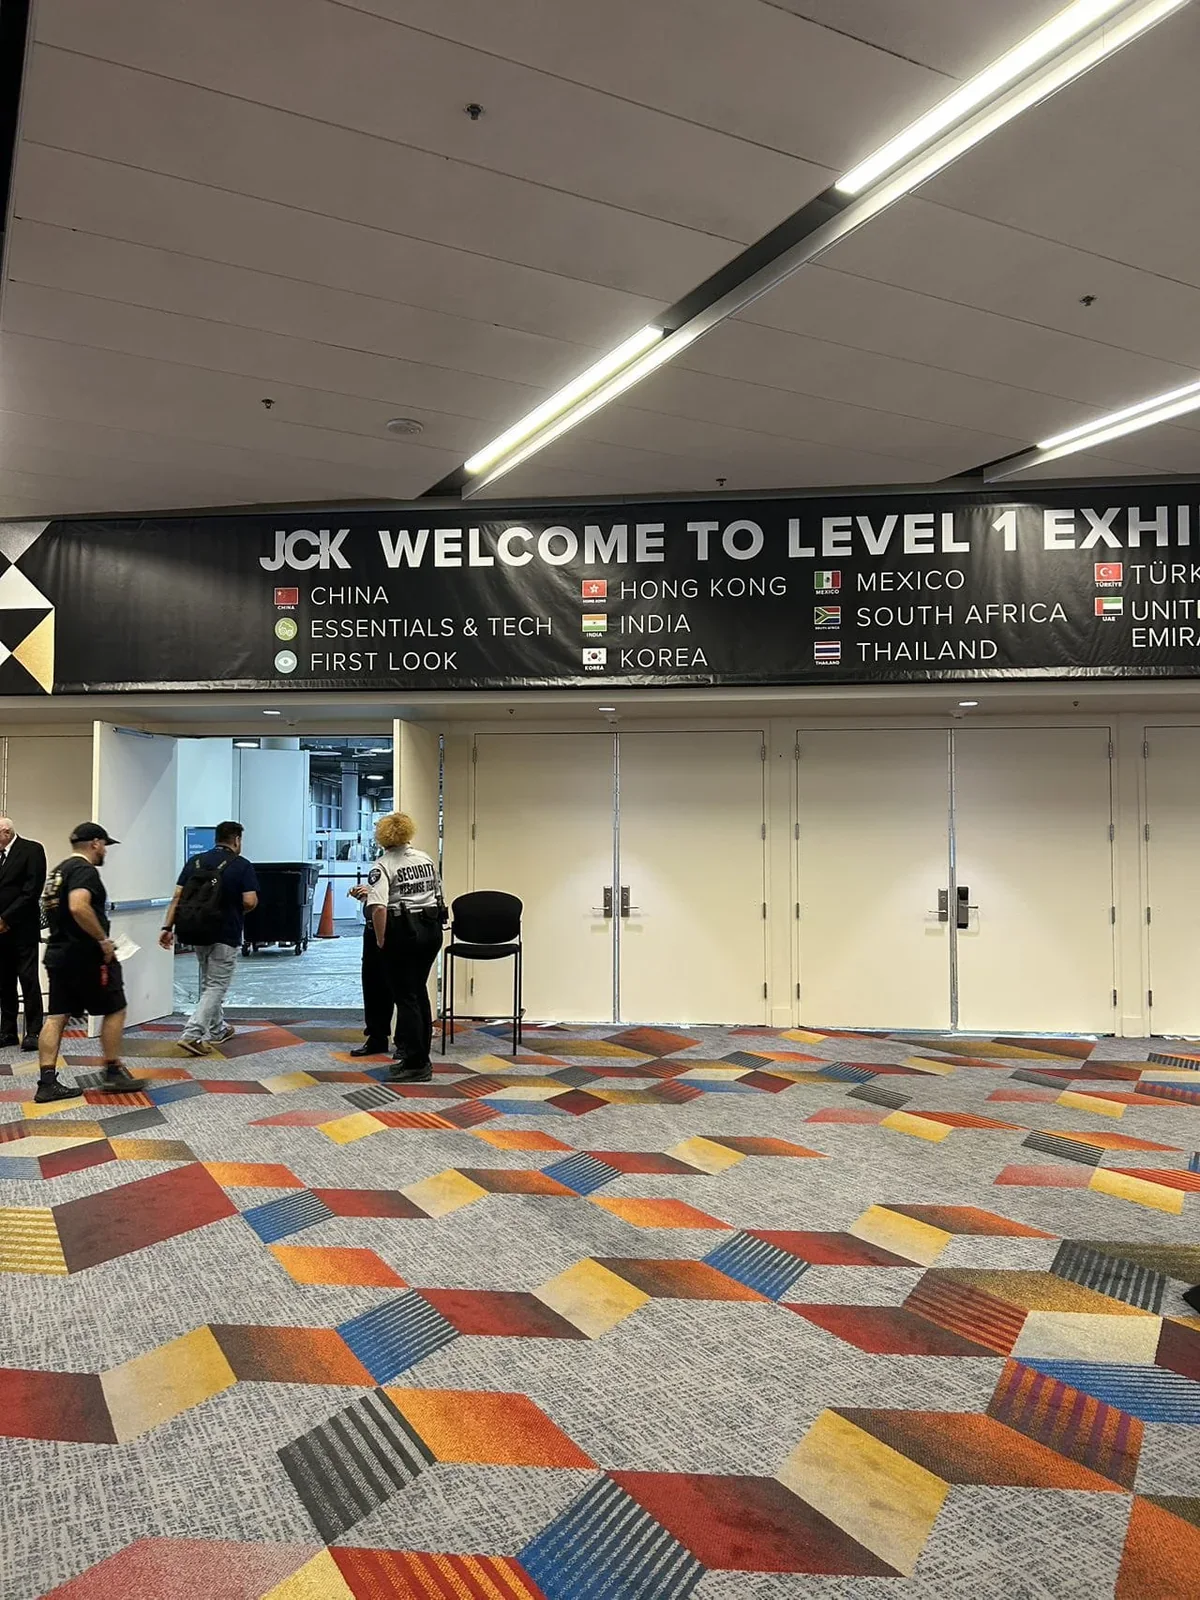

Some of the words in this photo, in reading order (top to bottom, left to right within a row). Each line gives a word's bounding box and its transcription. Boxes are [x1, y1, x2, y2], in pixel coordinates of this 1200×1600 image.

[259, 529, 352, 571] JCK
[378, 523, 665, 569] WELCOME
[686, 520, 764, 561] TO
[788, 513, 970, 558] LEVEL
[991, 510, 1016, 551] 1
[1043, 505, 1200, 550] EXHI
[621, 579, 698, 600] HONG
[710, 576, 787, 598] KONG
[857, 570, 965, 592] MEXICO
[310, 586, 389, 605] CHINA
[856, 606, 953, 627] SOUTH
[964, 602, 1068, 624] AFRICA
[1131, 599, 1200, 621] UNIT
[311, 618, 454, 638] ESSENTIALS
[463, 617, 478, 637] &
[487, 617, 552, 636] TECH
[621, 613, 691, 634] INDIA
[311, 652, 378, 671] FIRST
[389, 651, 458, 671] LOOK
[621, 647, 708, 668] KOREA
[856, 640, 998, 662] THAILAND
